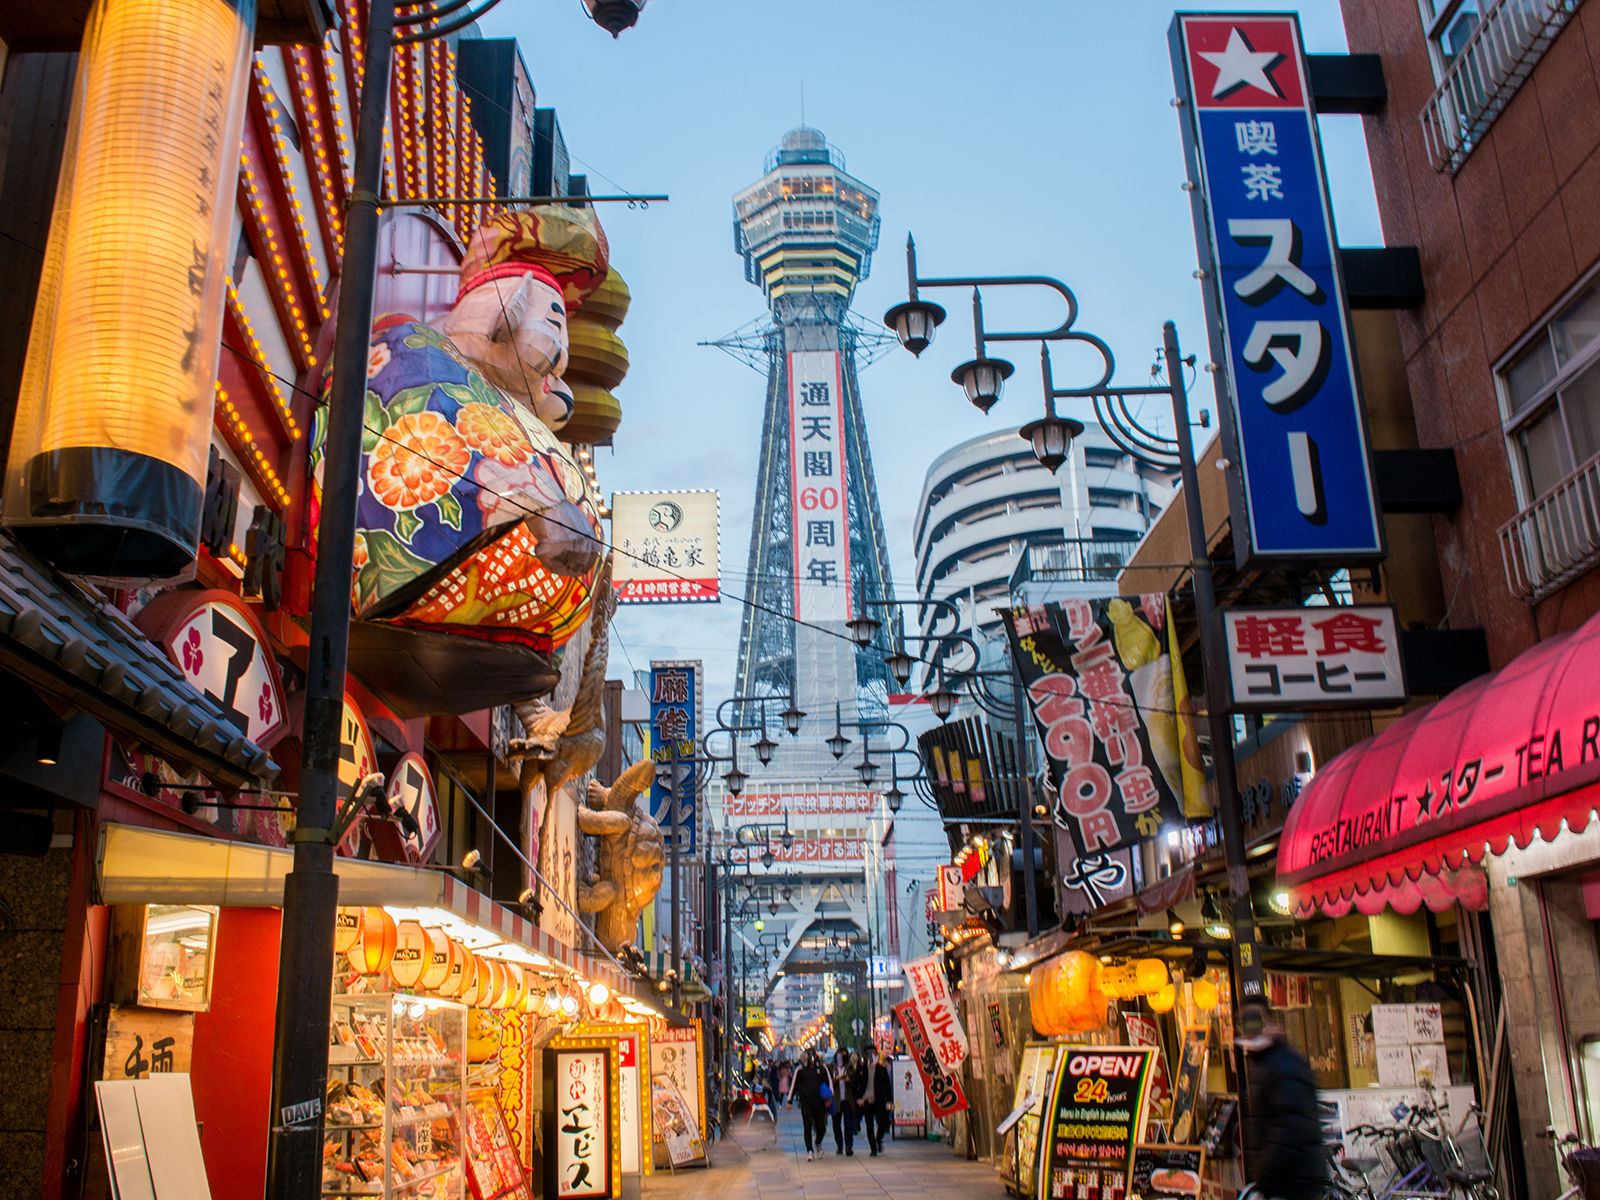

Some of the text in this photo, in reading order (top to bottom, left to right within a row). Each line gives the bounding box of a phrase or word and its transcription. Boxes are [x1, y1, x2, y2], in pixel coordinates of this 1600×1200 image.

[1226, 121, 1330, 526] 喫茶 スター
[800, 381, 839, 588] 通天閣60周年
[627, 581, 702, 596] 24時間営業中
[1233, 612, 1388, 659] 軽食
[1244, 660, 1387, 696] コーヒー
[652, 669, 691, 741] 麻雀
[1027, 671, 1123, 853] 290円
[1308, 794, 1408, 867] RESTAURANT
[1436, 756, 1506, 818] スター
[1515, 728, 1564, 788] TEA
[1069, 1054, 1143, 1079] OPEN!
[1073, 1077, 1128, 1103] 24 hours
[284, 1099, 320, 1124] DAVE
[1081, 1107, 1100, 1122] English
[1105, 1108, 1131, 1122] available
